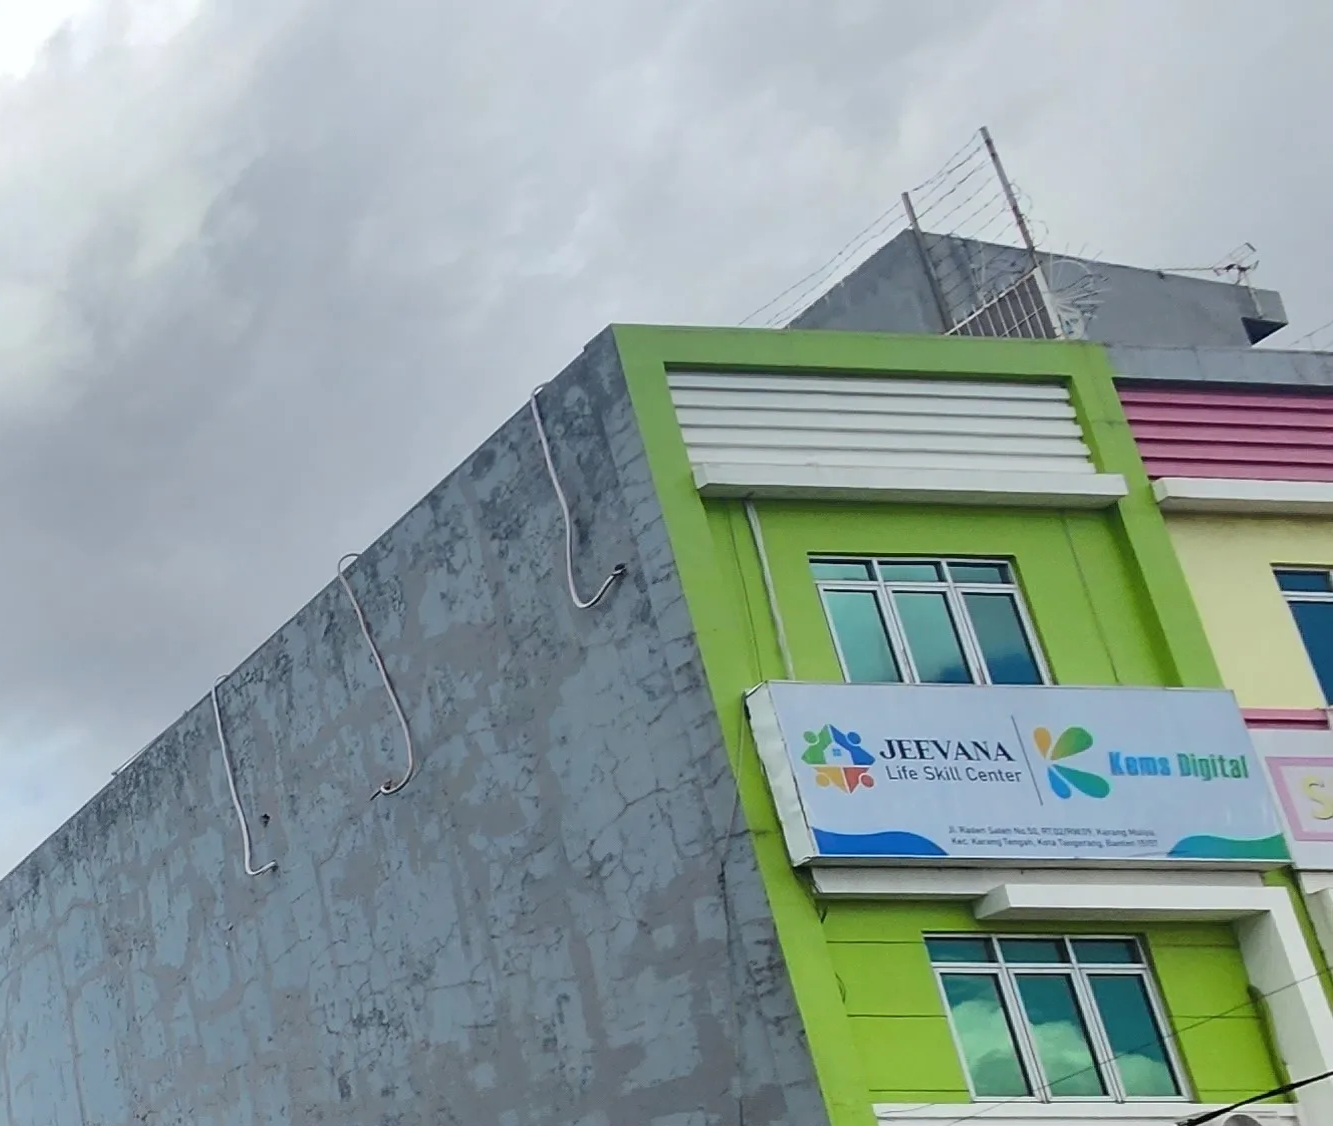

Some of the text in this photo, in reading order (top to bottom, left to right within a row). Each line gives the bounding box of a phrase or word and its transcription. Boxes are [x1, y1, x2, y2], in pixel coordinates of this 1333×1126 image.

[879, 738, 1017, 763] JEEVANA
[886, 765, 1022, 783] Life Skill Center
[1177, 754, 1250, 782] Digital
